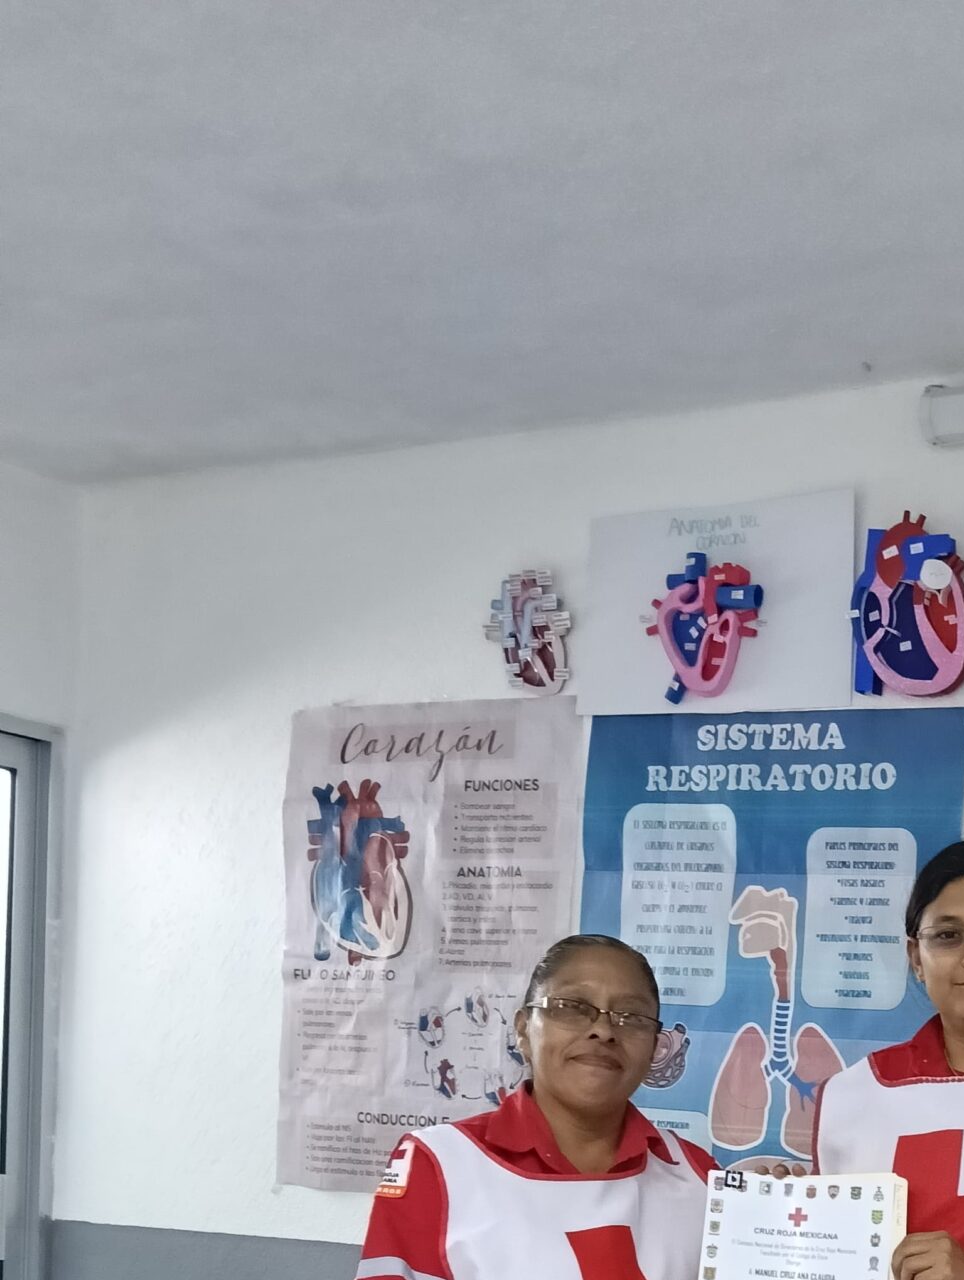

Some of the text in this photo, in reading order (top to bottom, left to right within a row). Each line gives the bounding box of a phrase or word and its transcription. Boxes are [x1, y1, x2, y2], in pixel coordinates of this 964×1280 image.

[697, 722, 846, 751] SISTEMA
[340, 723, 503, 782] Corazón
[645, 762, 897, 792] RESPIRATORIO
[464, 779, 540, 792] FUNCIONES
[457, 866, 522, 878] ANATOMIA
[294, 969, 396, 981] FLO SANUIEO
[357, 1111, 437, 1127] CONDUCCION
[754, 1227, 839, 1240] CRUZ ROJA MEXICANA
[754, 1268, 778, 1278] MANUEL
[779, 1270, 795, 1279] CRUZ
[797, 1272, 809, 1280] ANA
[811, 1273, 836, 1280] CLAUDIA
